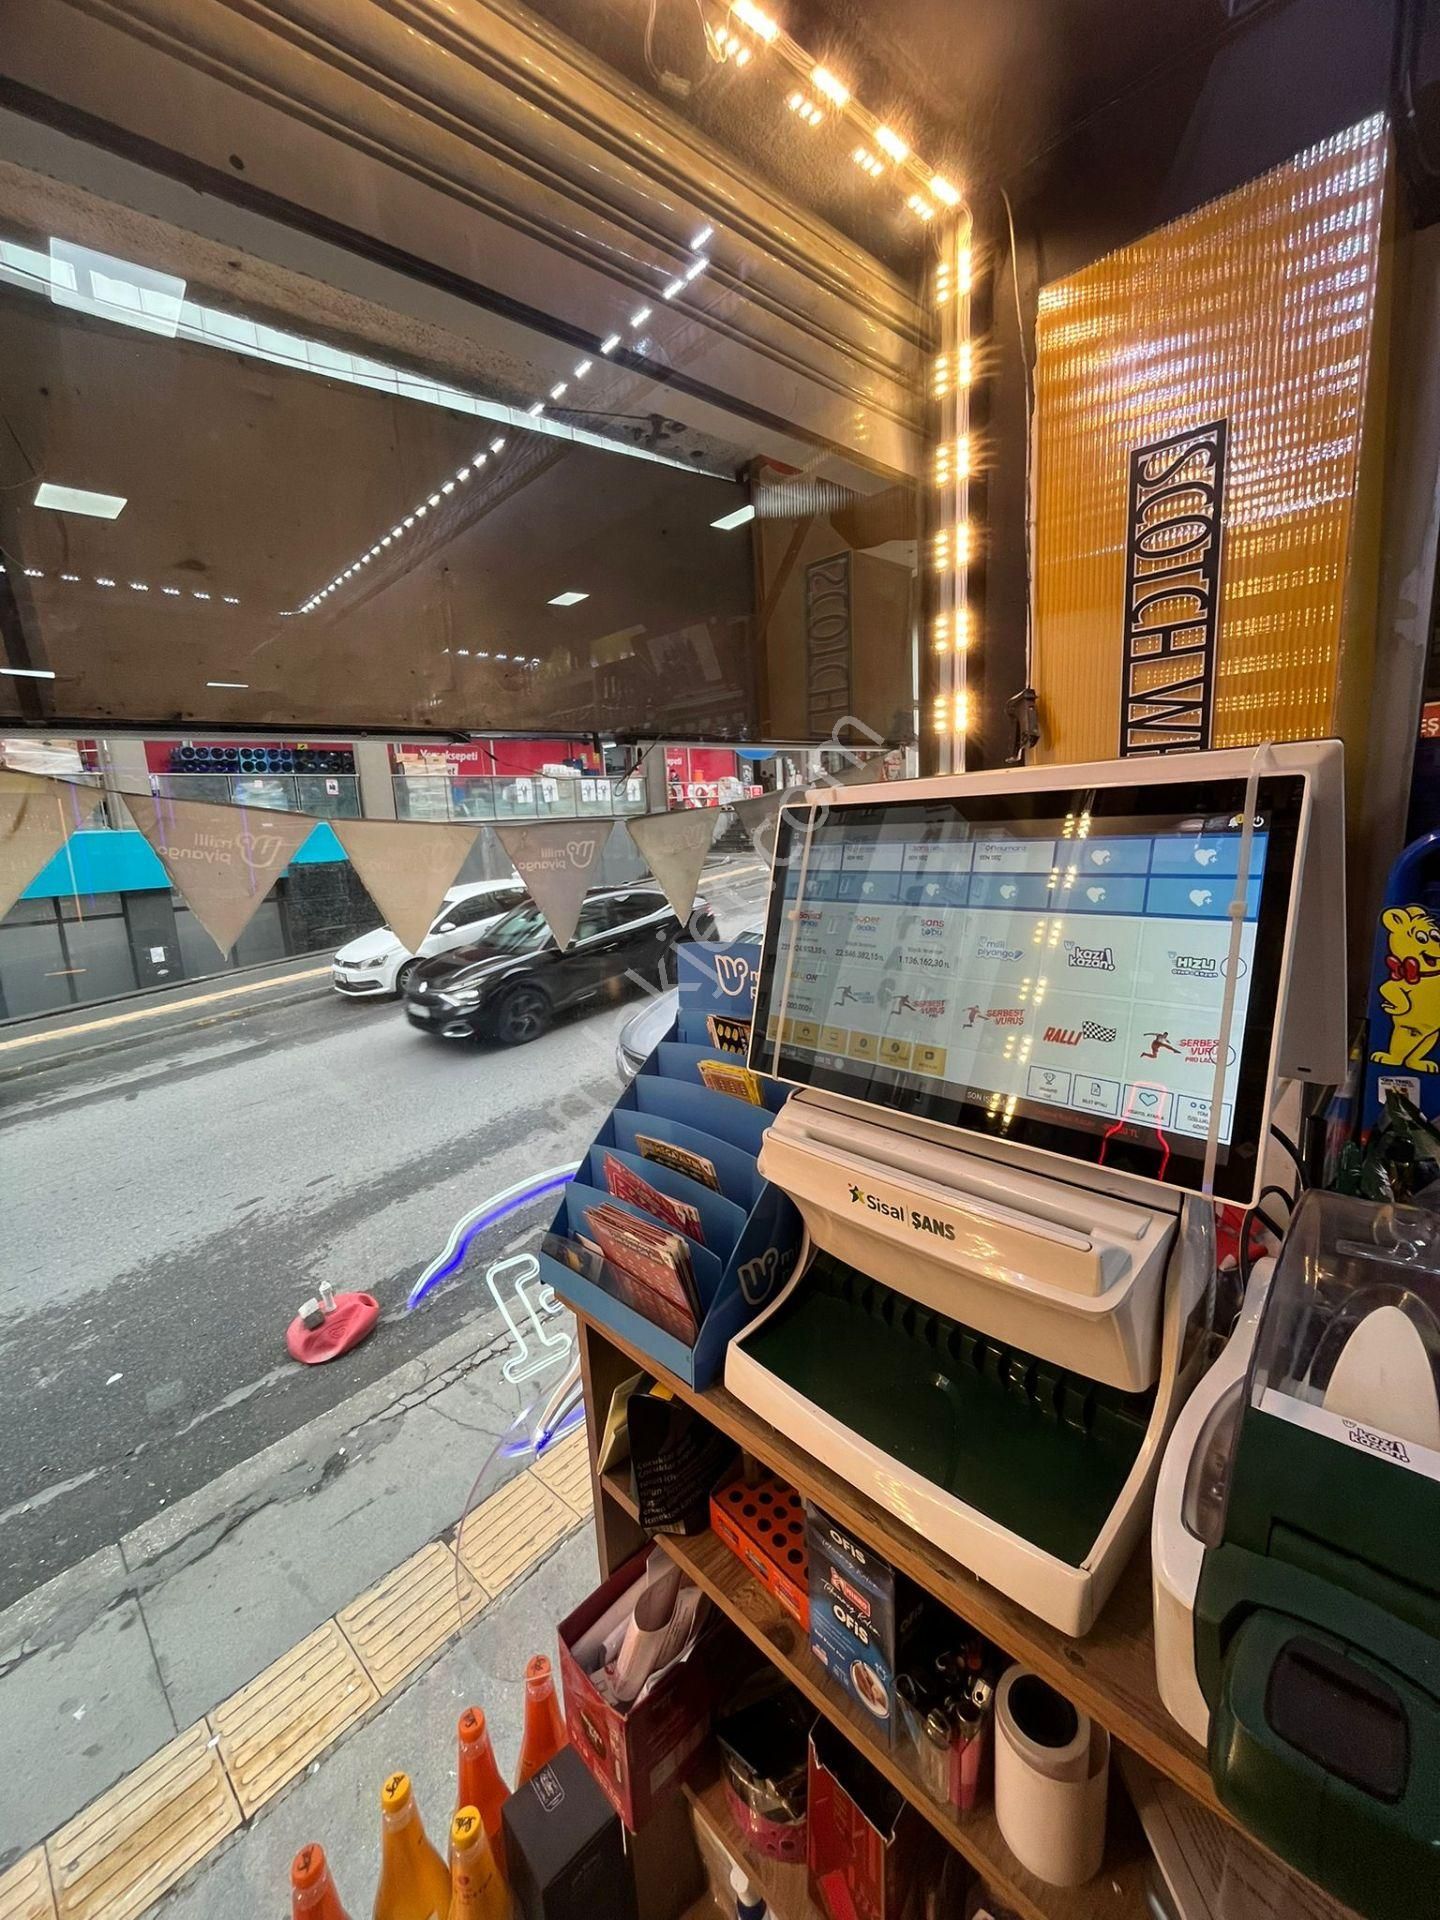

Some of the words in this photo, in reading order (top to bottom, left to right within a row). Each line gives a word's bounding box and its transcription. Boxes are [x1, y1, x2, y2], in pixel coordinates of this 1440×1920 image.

[1131, 441, 1217, 664] SCOTCH
[986, 1009, 1025, 1017] SERBEST
[1179, 1039, 1220, 1048] SERBES
[866, 1194, 904, 1221] Sisal
[911, 1211, 955, 1241] ŞANS
